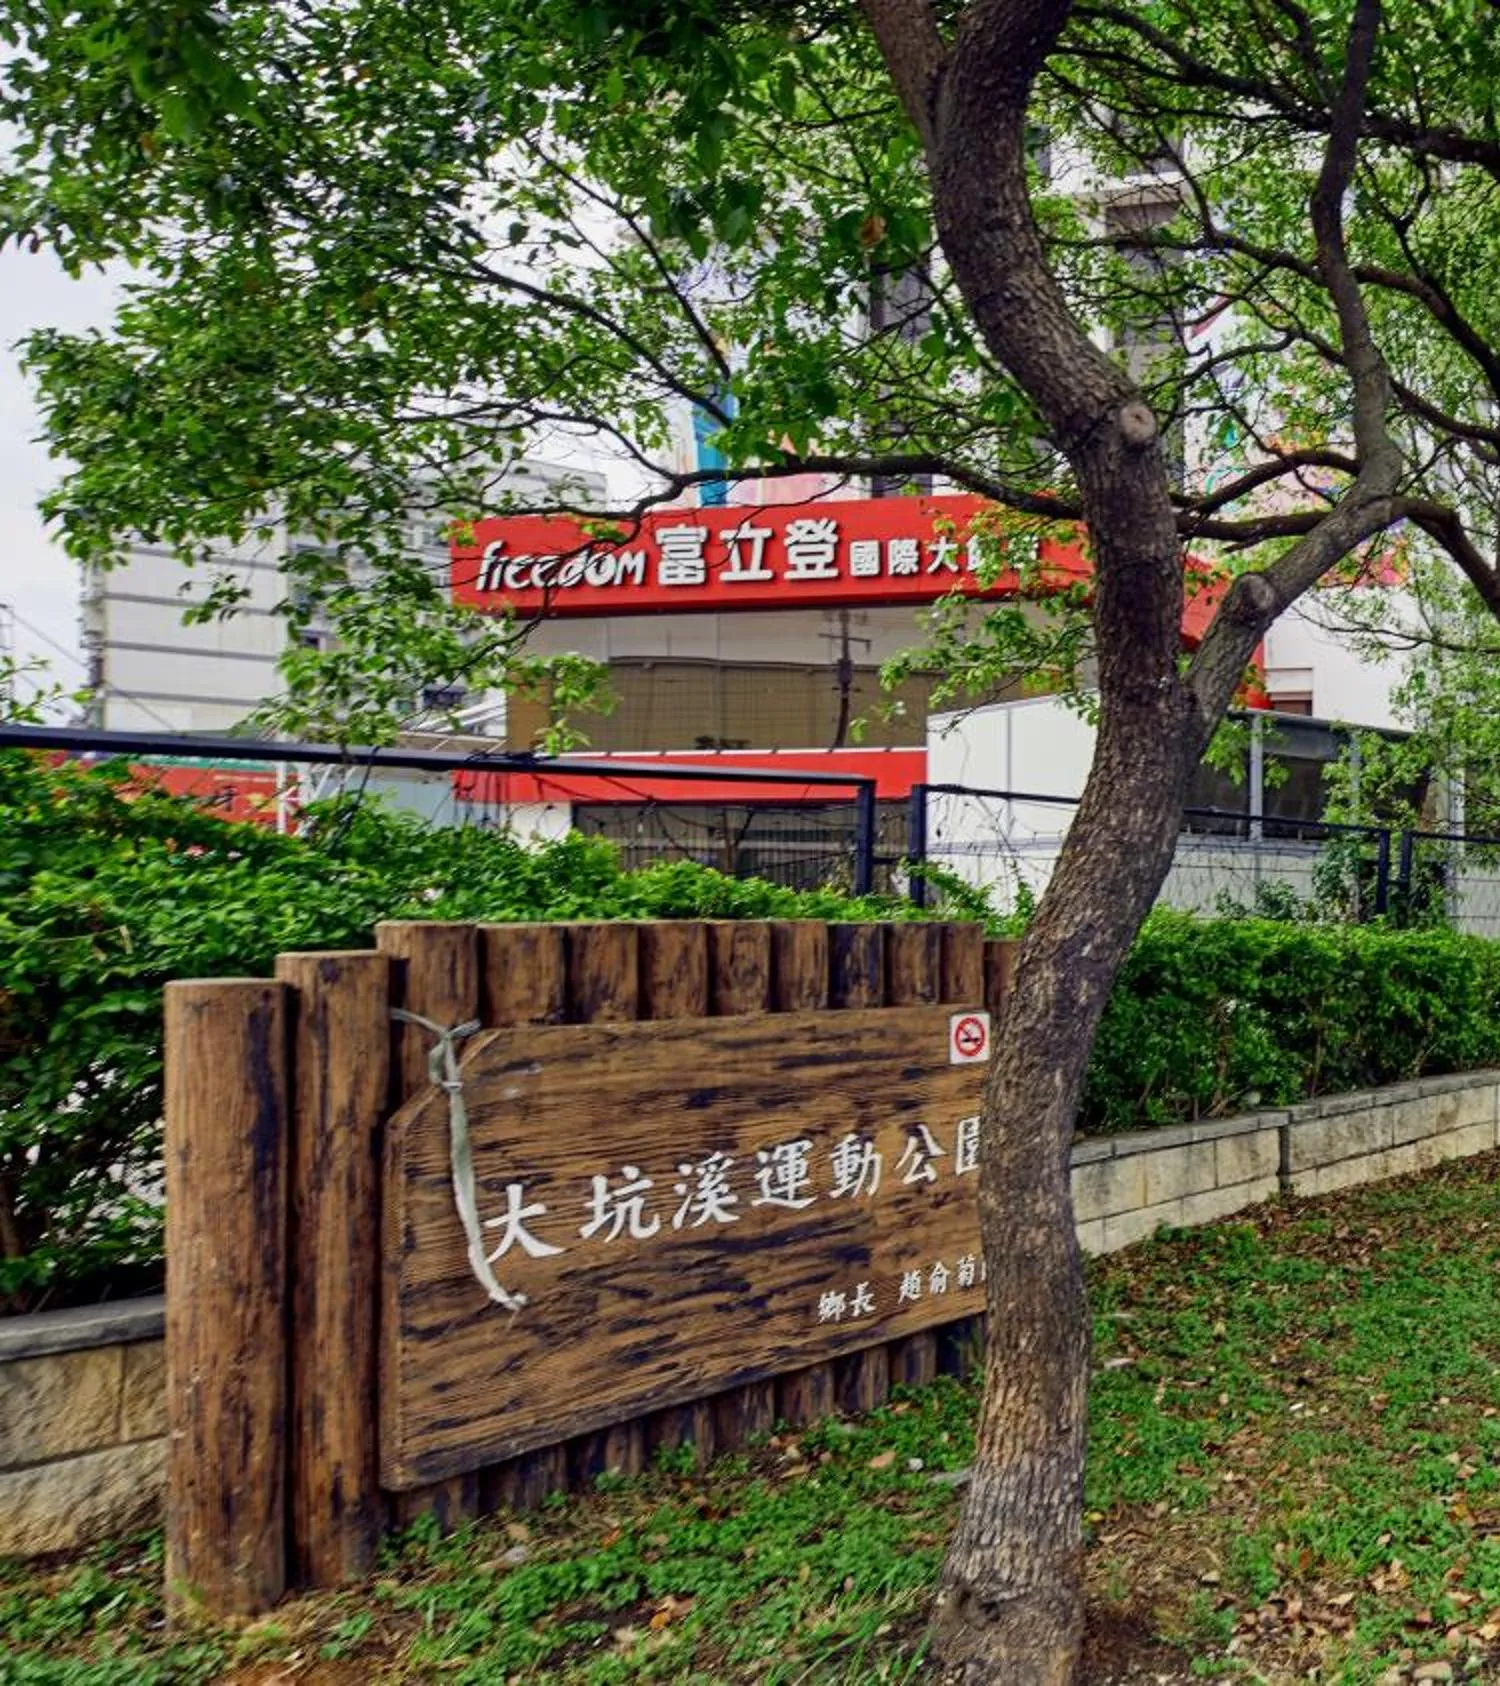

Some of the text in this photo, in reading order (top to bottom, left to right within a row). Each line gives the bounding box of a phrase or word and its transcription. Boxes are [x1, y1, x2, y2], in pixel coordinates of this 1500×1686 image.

[484, 1115, 980, 1265] 大坑溪運動公園
[817, 1281, 876, 1325] 鄉長
